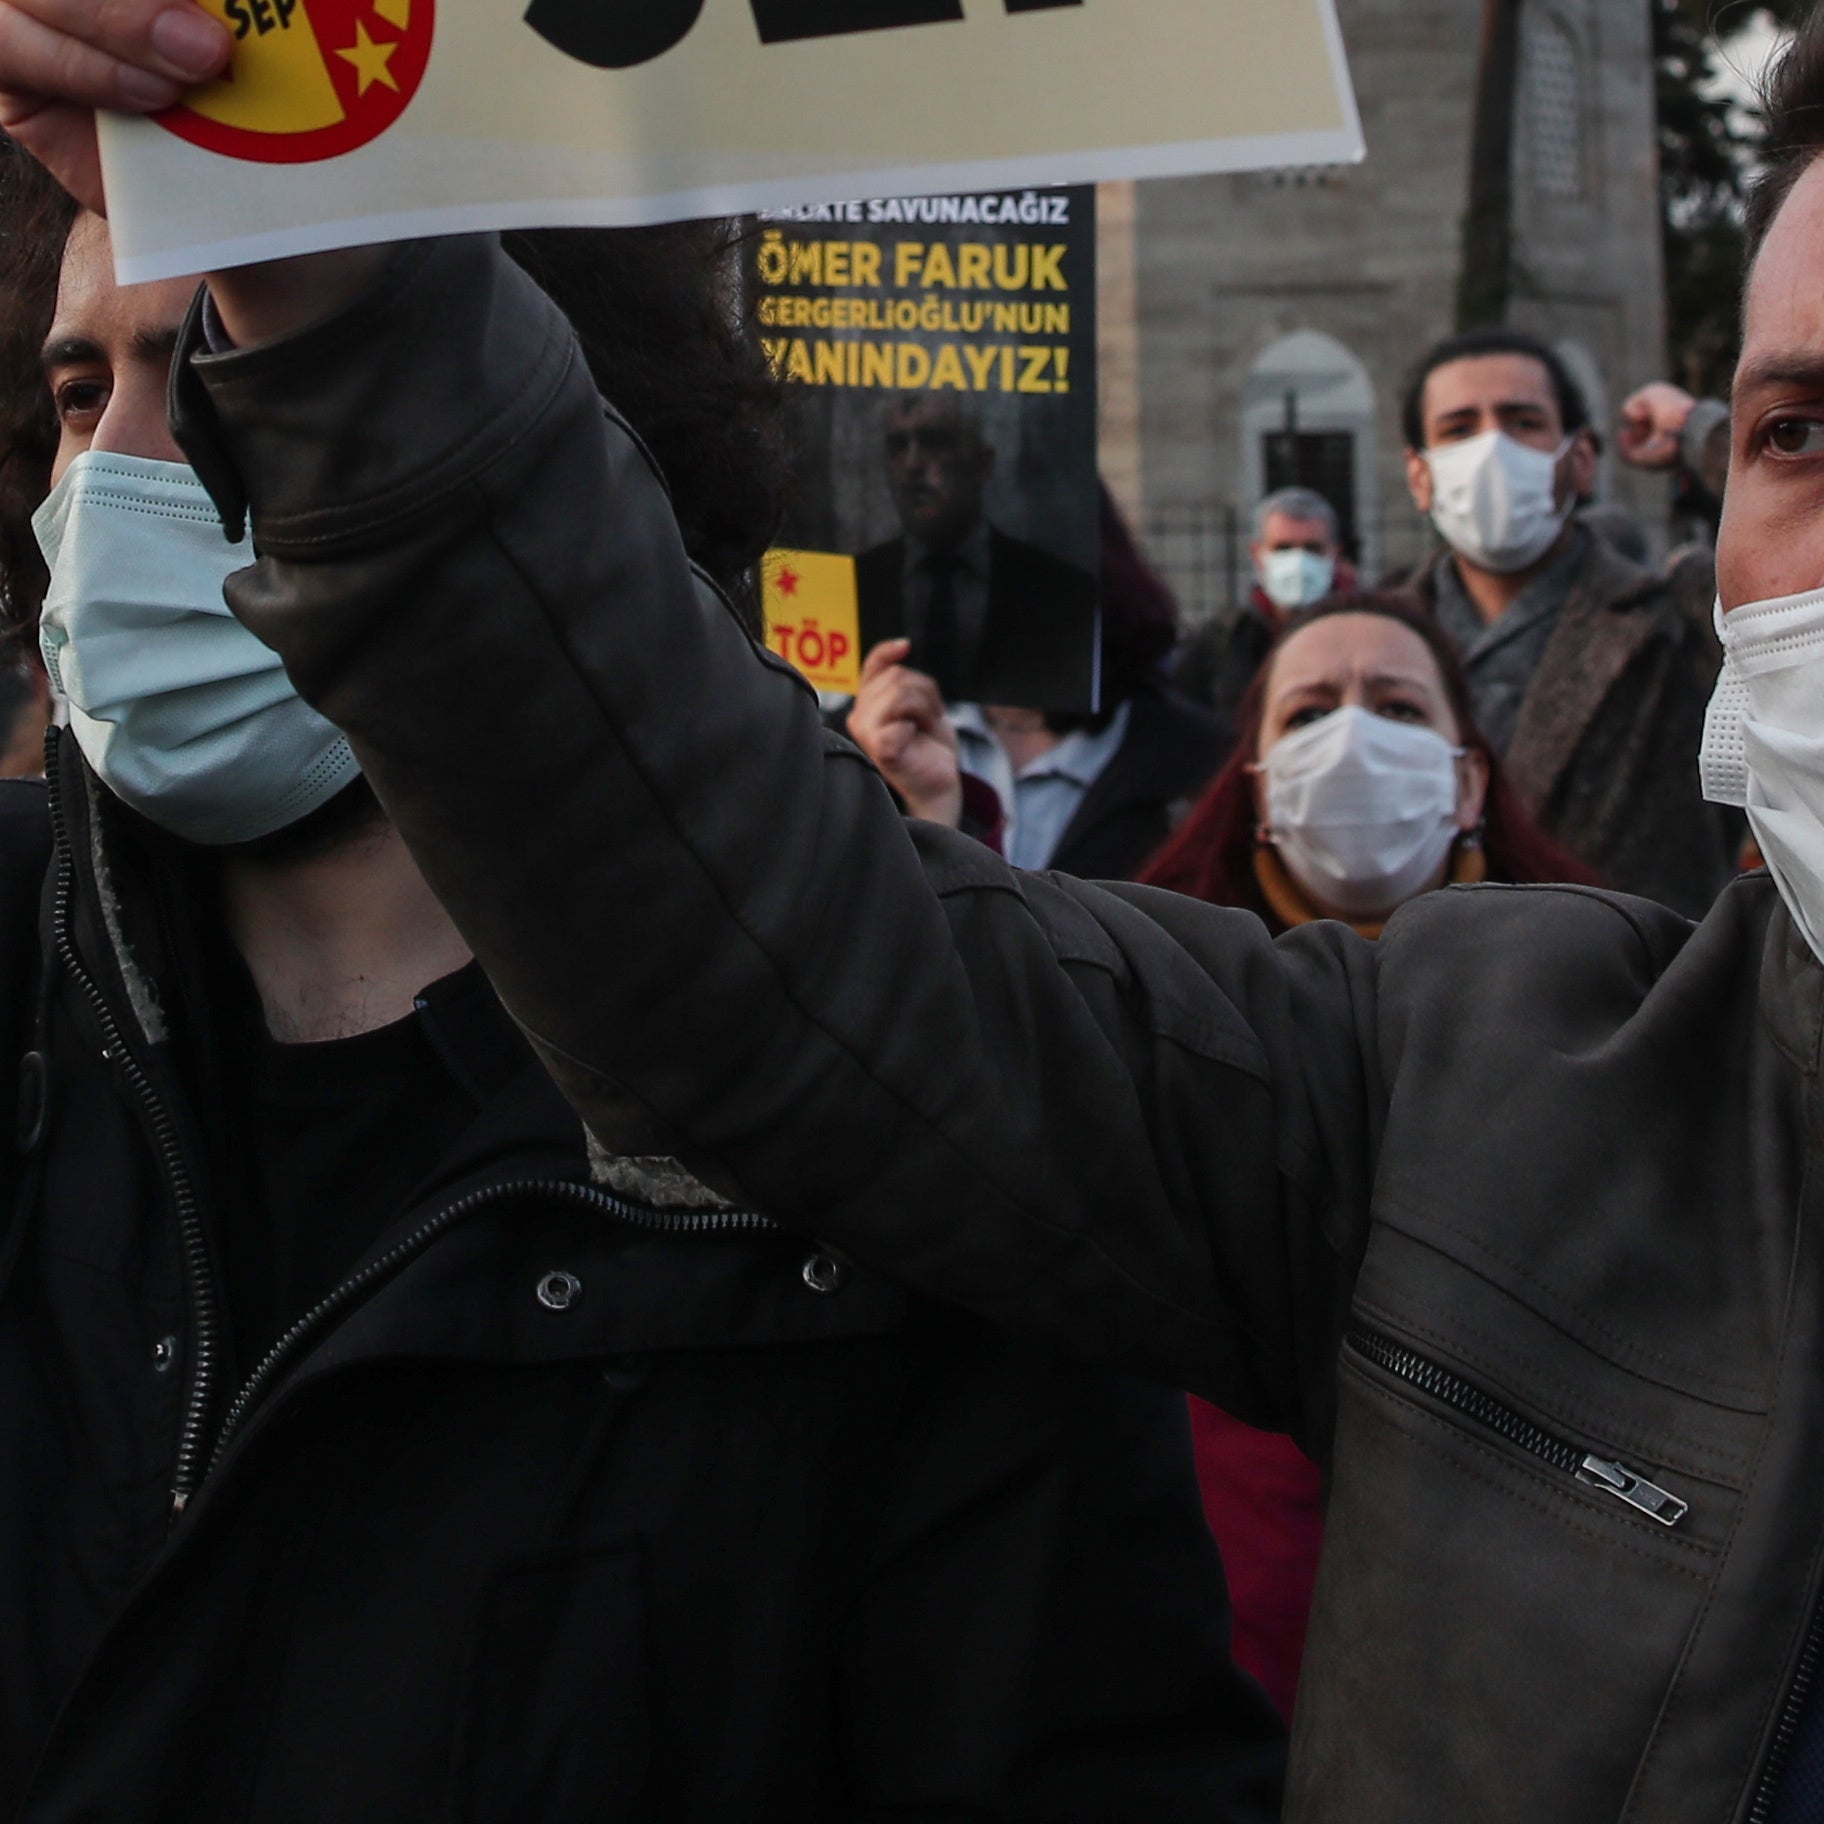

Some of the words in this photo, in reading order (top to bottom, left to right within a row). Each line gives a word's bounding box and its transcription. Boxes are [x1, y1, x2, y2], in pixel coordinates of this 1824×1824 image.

[867, 191, 1070, 225] SAVUNACAĞIZ
[757, 229, 883, 288] ÖMER
[894, 242, 1069, 292] FARUK
[759, 293, 1070, 335] GERGERLİOĞLU'NUN
[760, 337, 1070, 394] YANINDAYIZ!
[773, 618, 849, 669] TÖP
